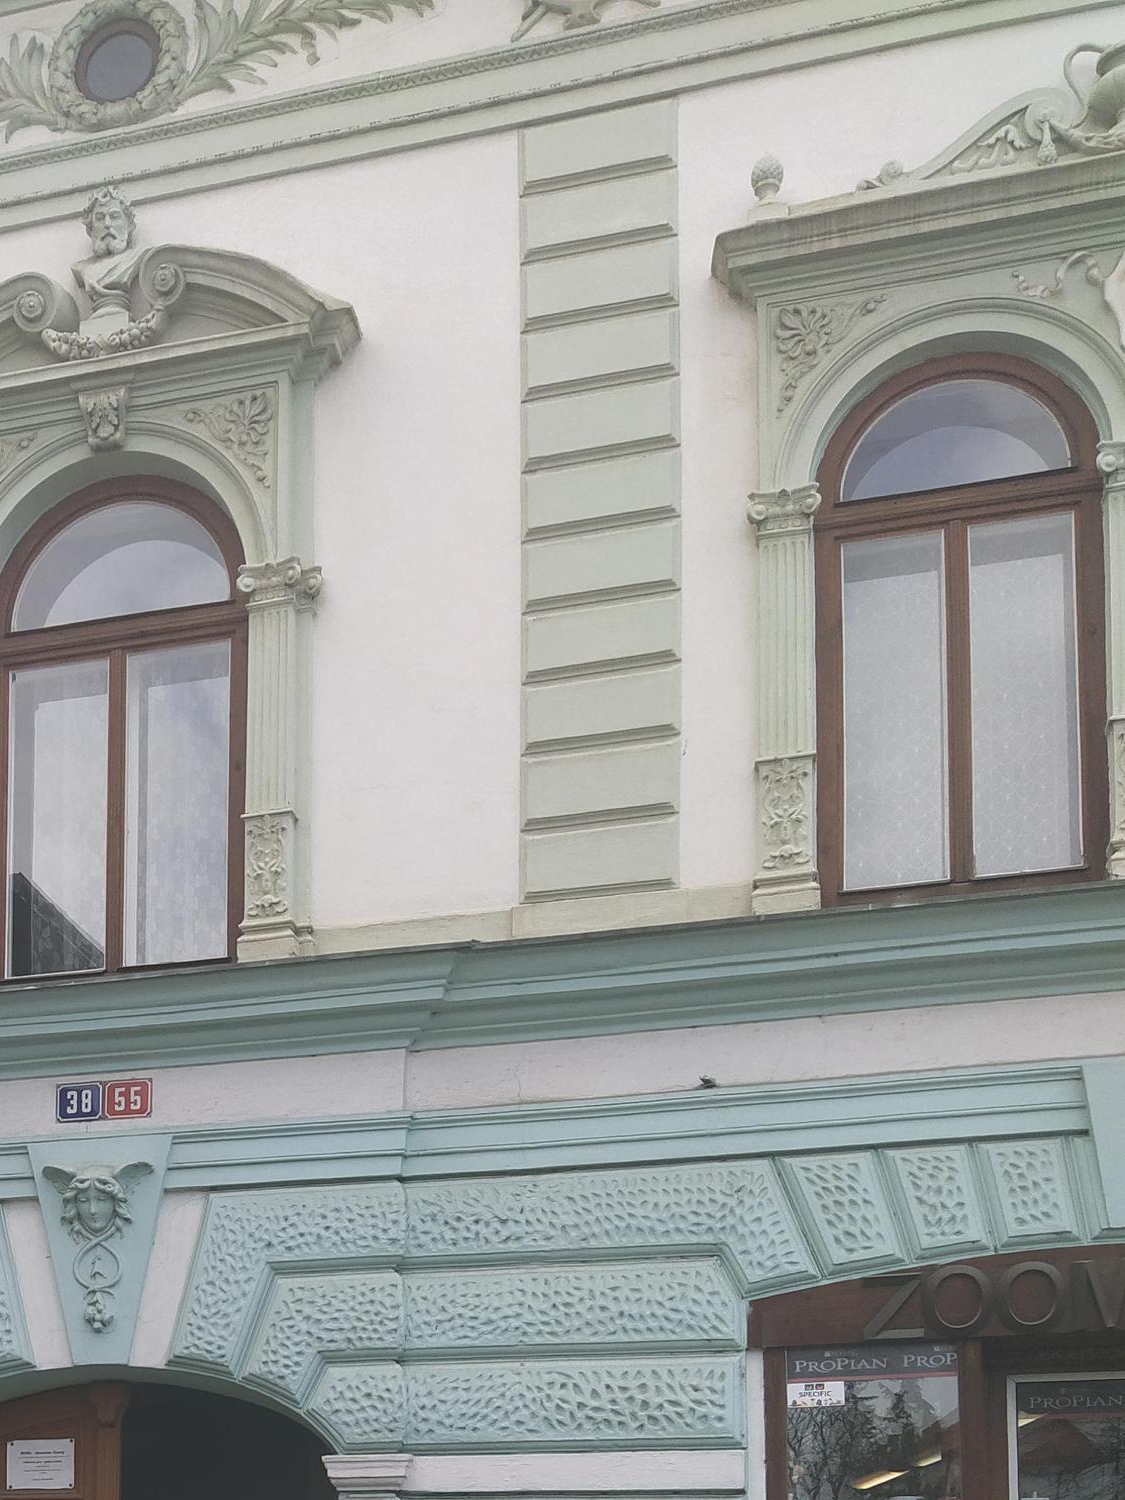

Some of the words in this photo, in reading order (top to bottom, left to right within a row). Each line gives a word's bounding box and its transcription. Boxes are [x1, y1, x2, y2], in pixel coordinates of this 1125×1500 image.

[66, 1089, 92, 1114] 38
[114, 1086, 141, 1111] 55
[798, 1390, 832, 1398] SPECIFIC
